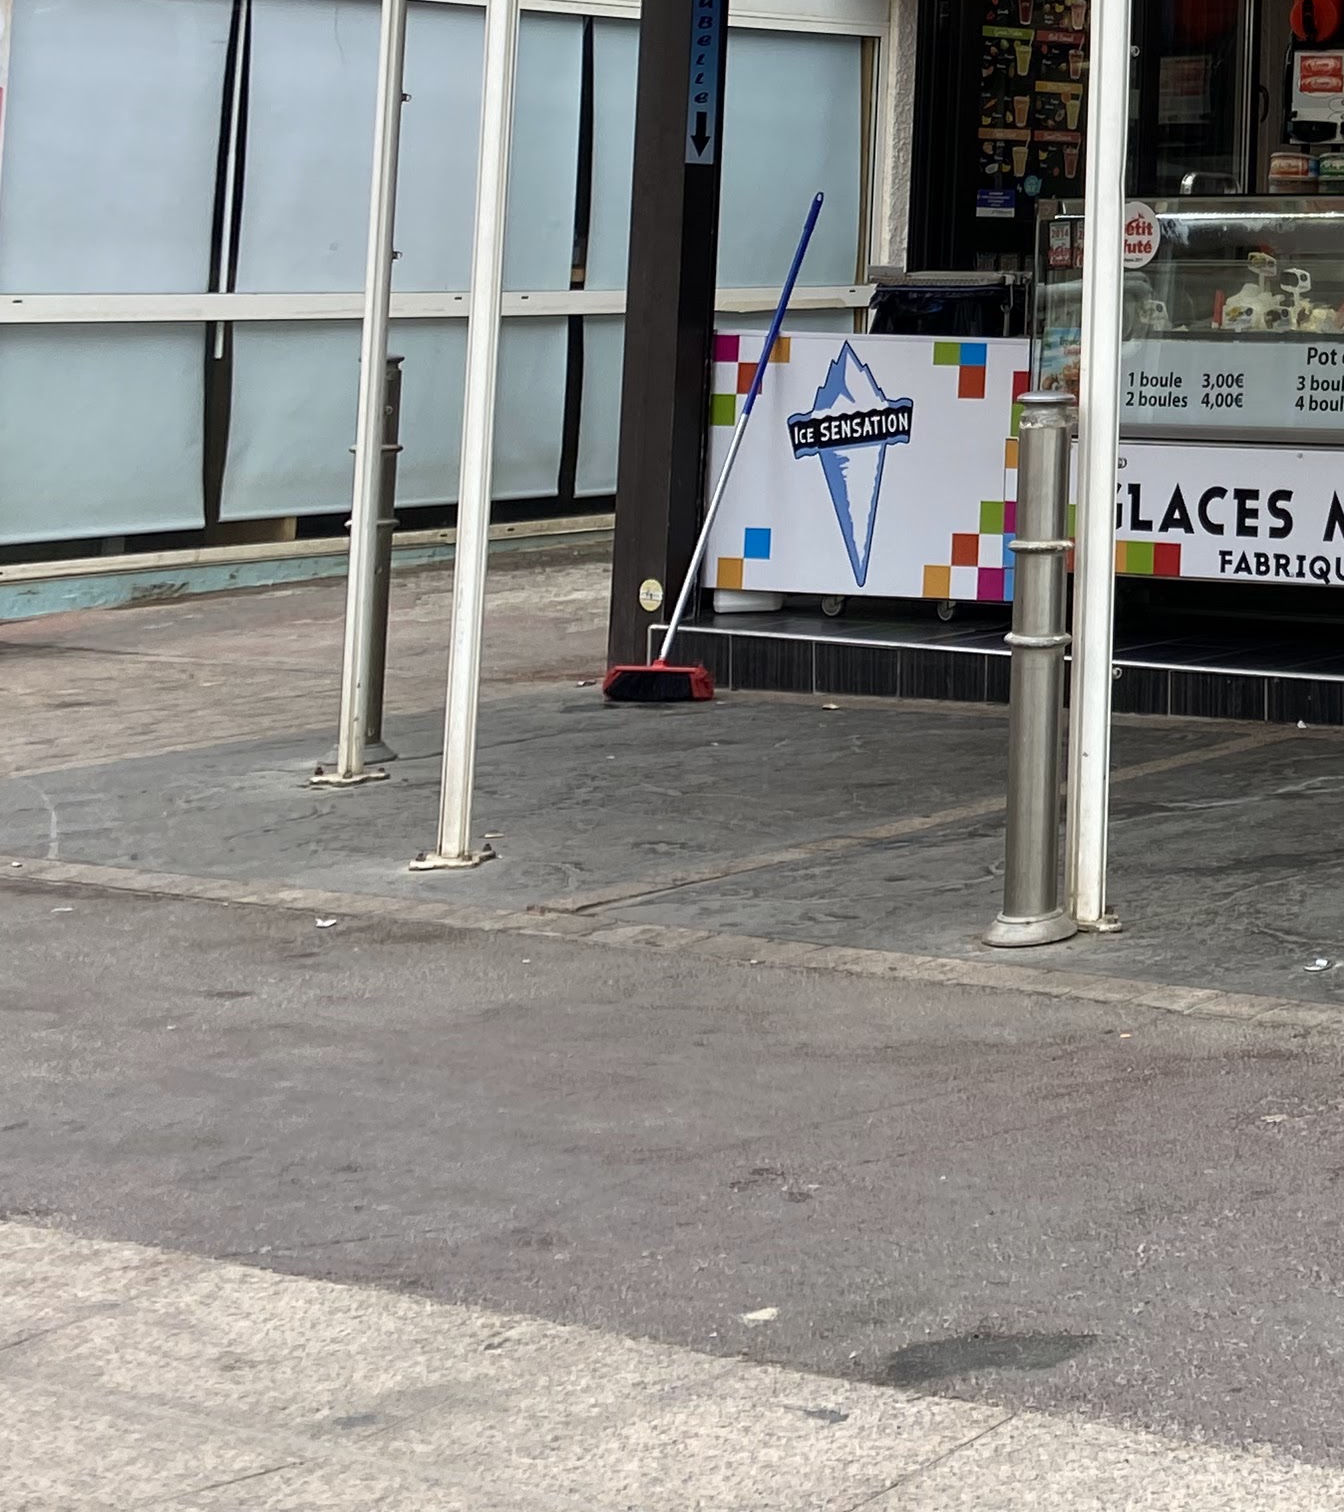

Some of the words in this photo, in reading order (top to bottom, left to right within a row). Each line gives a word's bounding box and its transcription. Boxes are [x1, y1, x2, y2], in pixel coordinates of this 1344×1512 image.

[1306, 347, 1337, 367] Pot
[1128, 372, 1135, 387] 1
[1139, 372, 1182, 388] boule
[1202, 372, 1244, 390] 3,00€
[1297, 375, 1306, 391] 3
[1126, 392, 1135, 407] 2
[1139, 391, 1188, 409] boules
[1201, 393, 1244, 411] 4,00€
[1295, 396, 1305, 411] 4
[794, 425, 815, 446] ICE
[820, 412, 909, 442] SENSATION
